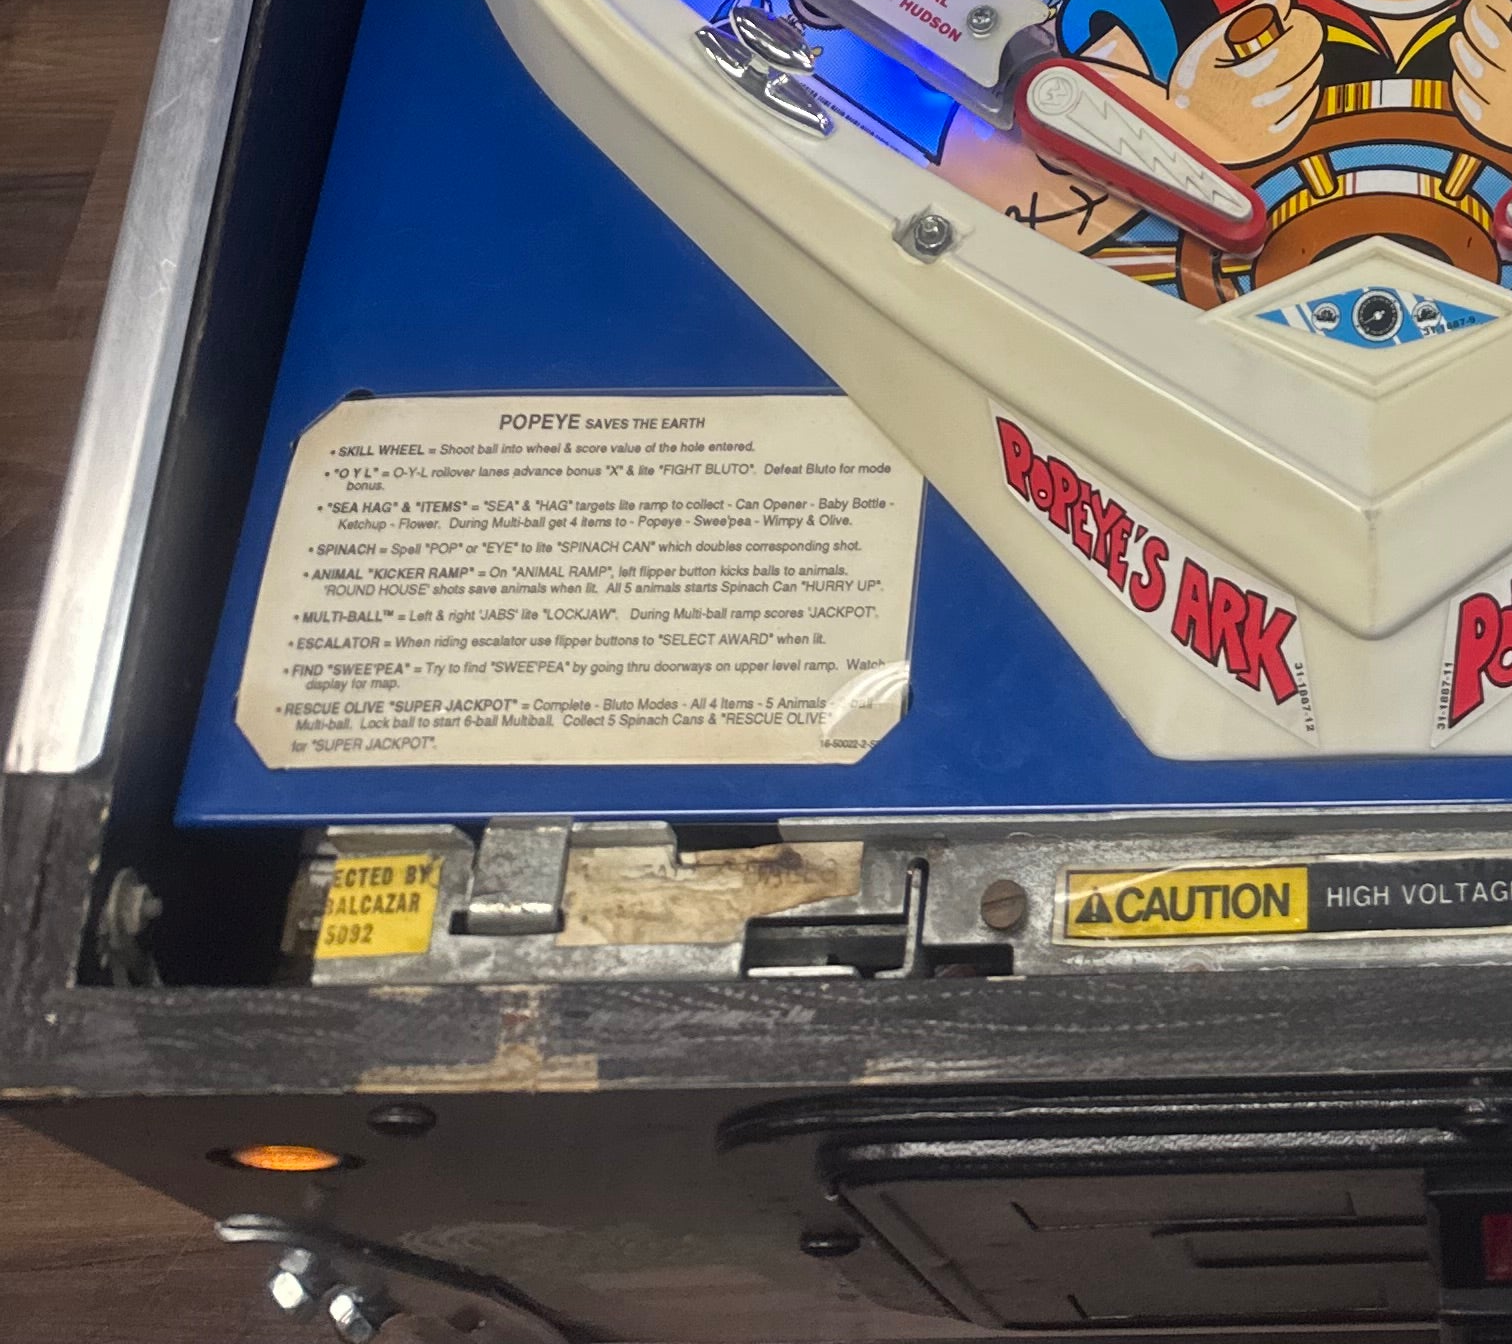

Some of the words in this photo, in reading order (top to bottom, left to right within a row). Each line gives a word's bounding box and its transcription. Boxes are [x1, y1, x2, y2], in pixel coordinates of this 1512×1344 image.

[499, 414, 581, 431] POPEYE
[585, 418, 629, 430] SAVES
[633, 418, 658, 430] THE
[661, 417, 706, 429] EARTH
[338, 446, 374, 457] SKILL
[379, 445, 425, 456] WHEEL
[439, 444, 475, 455] Shoot
[477, 444, 499, 455] ball
[501, 443, 523, 455] into
[526, 442, 561, 454] wheel
[564, 443, 572, 453] &
[575, 445, 607, 454] score
[610, 443, 641, 454] value
[645, 442, 656, 453] of
[659, 442, 677, 453] the
[680, 442, 705, 453] hole
[708, 441, 755, 452] entered.
[995, 416, 1169, 613] POPEYE'S
[1171, 556, 1299, 705] ARK
[296, 637, 380, 650] ESCALATOR
[395, 637, 431, 648] When
[434, 636, 468, 650] riding
[471, 636, 526, 648] escalator
[530, 638, 552, 647] use
[555, 635, 592, 649] flipper
[595, 635, 639, 647] buttons
[642, 635, 655, 646] to
[658, 634, 716, 646] "SELECT
[719, 633, 774, 645] AWARD"
[777, 633, 809, 645] when
[813, 633, 826, 645] lit.
[404, 864, 433, 885] BY
[1114, 882, 1290, 925] CAUTION
[1326, 885, 1390, 908] HIGH
